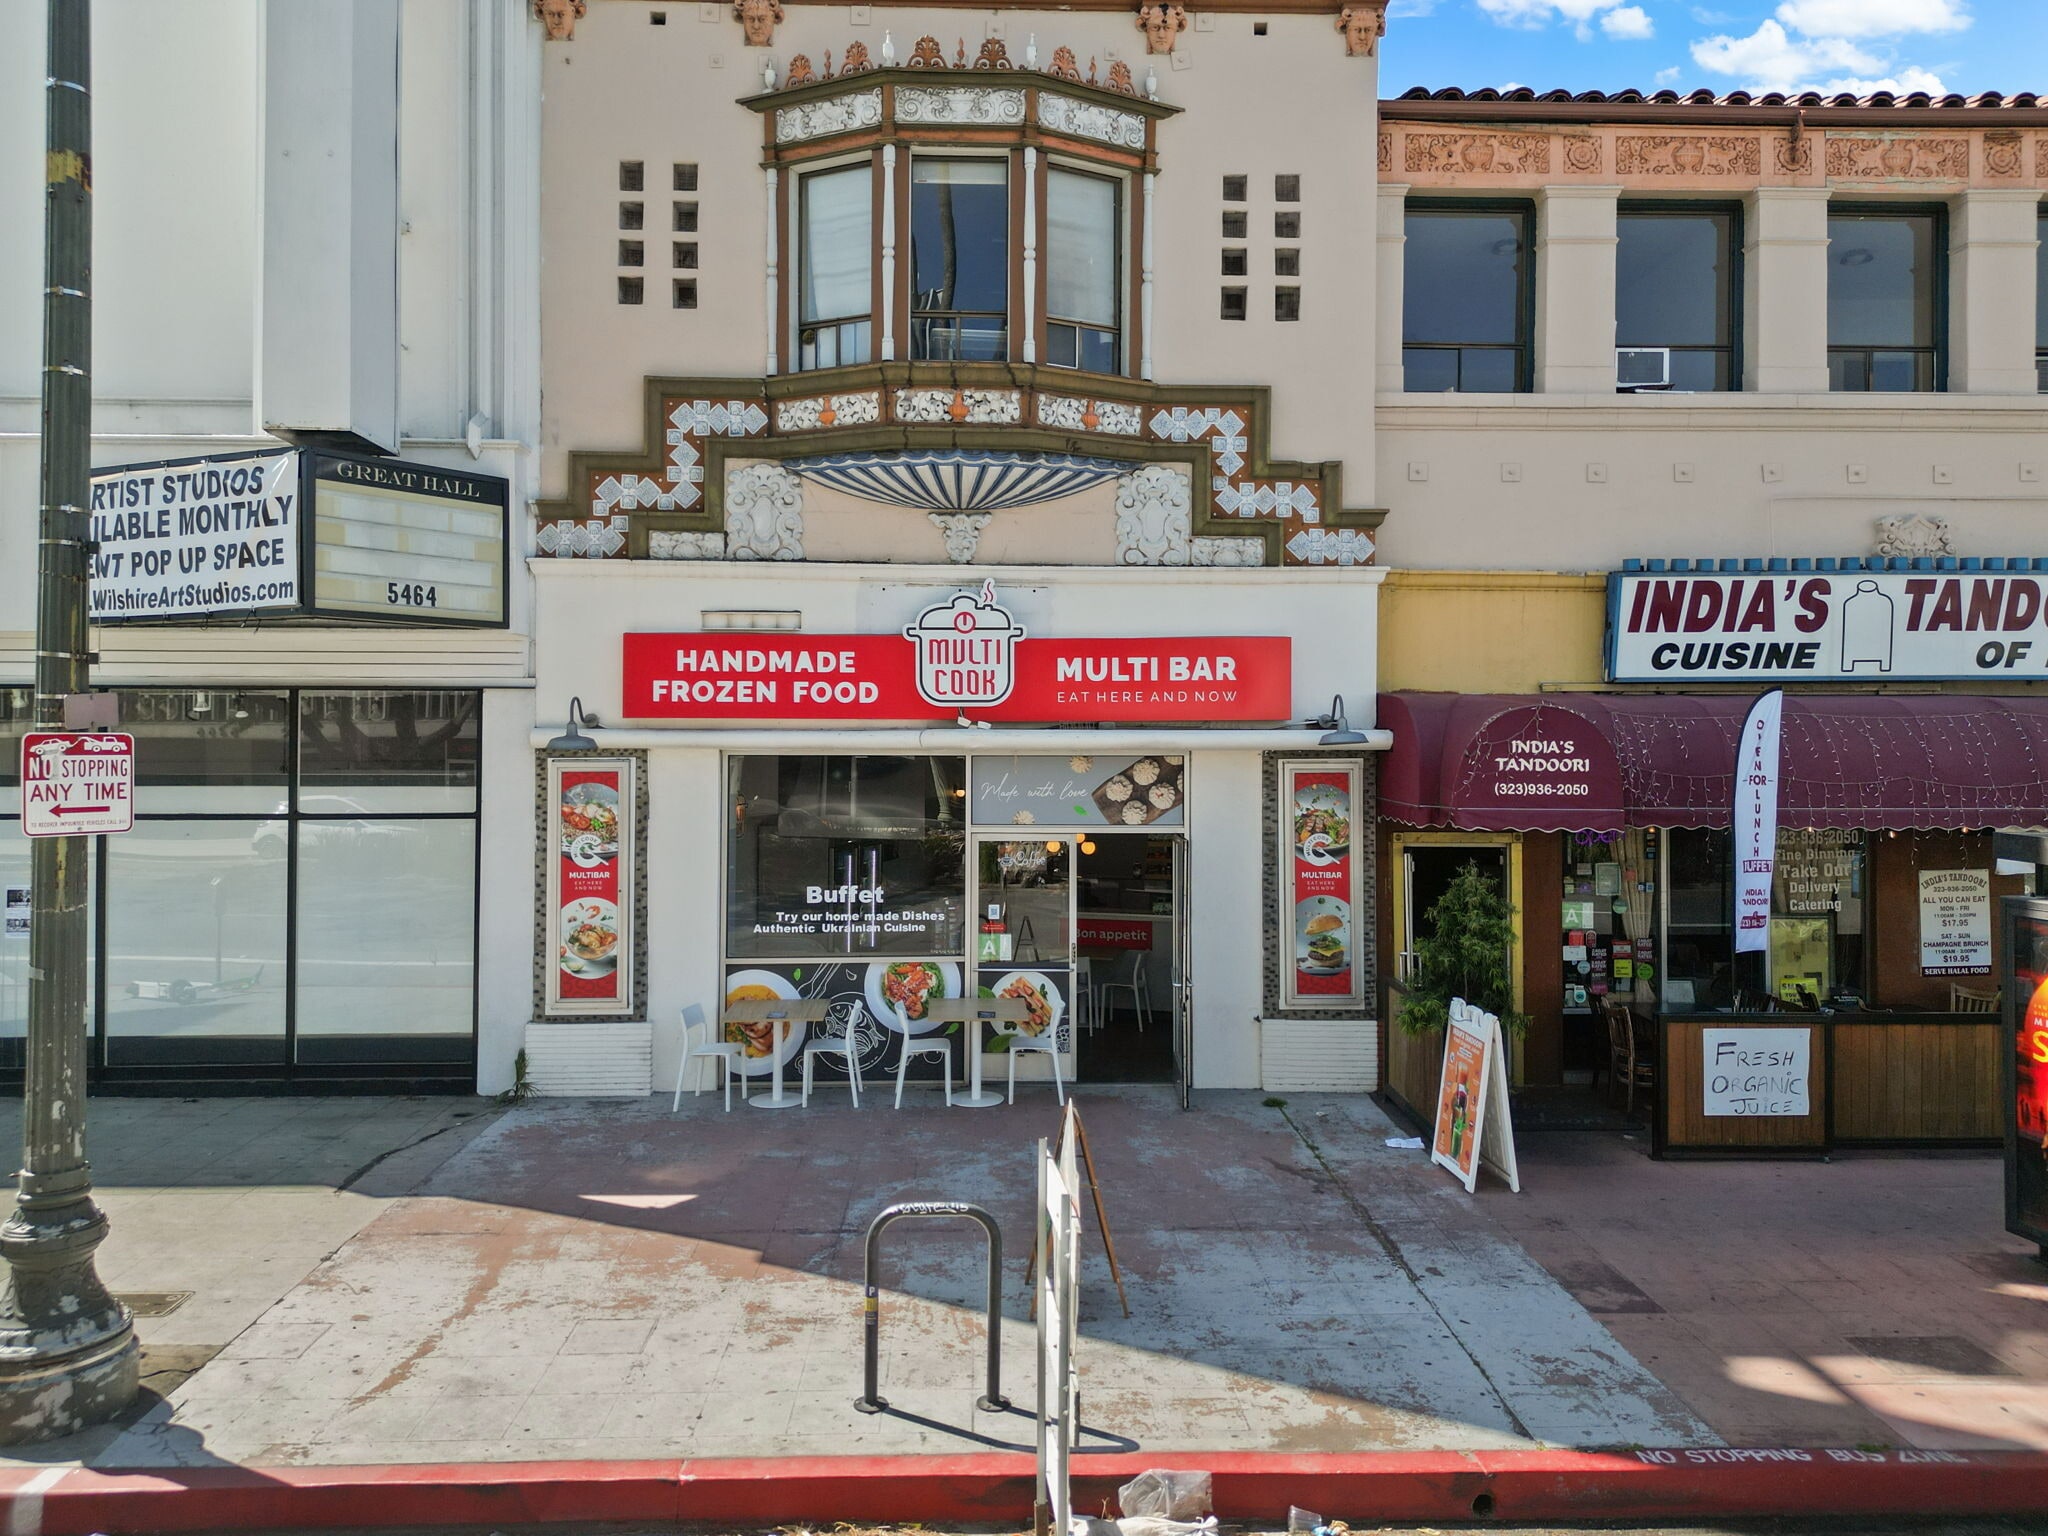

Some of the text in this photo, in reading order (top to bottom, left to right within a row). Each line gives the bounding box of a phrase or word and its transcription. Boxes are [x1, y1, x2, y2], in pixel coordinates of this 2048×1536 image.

[337, 462, 480, 497] GREAT HALL
[91, 466, 265, 511] RTIST STUDIOS
[91, 495, 293, 543] ILABLE MONTHLY
[89, 538, 285, 579] ENT POP UP SPACE
[89, 580, 294, 611] .WilshireArtStudios.com
[388, 582, 437, 607] 5464
[1627, 577, 1832, 633] INDIA'S
[929, 639, 1001, 665] MULTI
[1651, 641, 1821, 670] CUISINE
[1976, 641, 2032, 669] OF
[676, 650, 856, 674] HANDMADE
[1056, 656, 1237, 682] MULTI BAR
[934, 669, 995, 696] COOK
[652, 680, 879, 704] FROZEN FOOD
[1057, 691, 1237, 703] EAT HERE AND NOW
[1511, 740, 1575, 754] INDIA'S
[29, 756, 128, 779] NO STOPPING
[1494, 758, 1590, 772] TANDOORI
[981, 772, 1089, 803] Made with love
[1748, 775, 1767, 786] FOR
[30, 782, 127, 802] ANY TIME
[1494, 782, 1589, 796] (323)936-2050
[1753, 789, 1761, 858] LUNCH
[569, 871, 610, 879] MULTIBAR
[1301, 871, 1342, 879] MULTIBAR
[1780, 863, 1850, 878] Take Out
[1789, 882, 1841, 895] Delivery
[1921, 873, 1987, 890] INDIA'S TANDOORI
[806, 885, 884, 904] Buffet
[1789, 899, 1842, 912] Catering
[775, 911, 945, 924] Try our home made Dishes
[1565, 908, 1579, 923] A
[1941, 919, 1969, 927] $17.95
[753, 923, 926, 933] Authentic Ukrainian Cuisine
[1099, 929, 1148, 941] appetit
[982, 939, 997, 955] A
[1943, 955, 1970, 963] $19.95
[1947, 967, 1970, 975] HALAL
[1715, 1042, 1794, 1067] FRESH
[868, 1286, 876, 1296] P
[1638, 1450, 1677, 1464] NO
[1685, 1449, 1812, 1463] STOPPING
[1825, 1449, 1886, 1463] BUS
